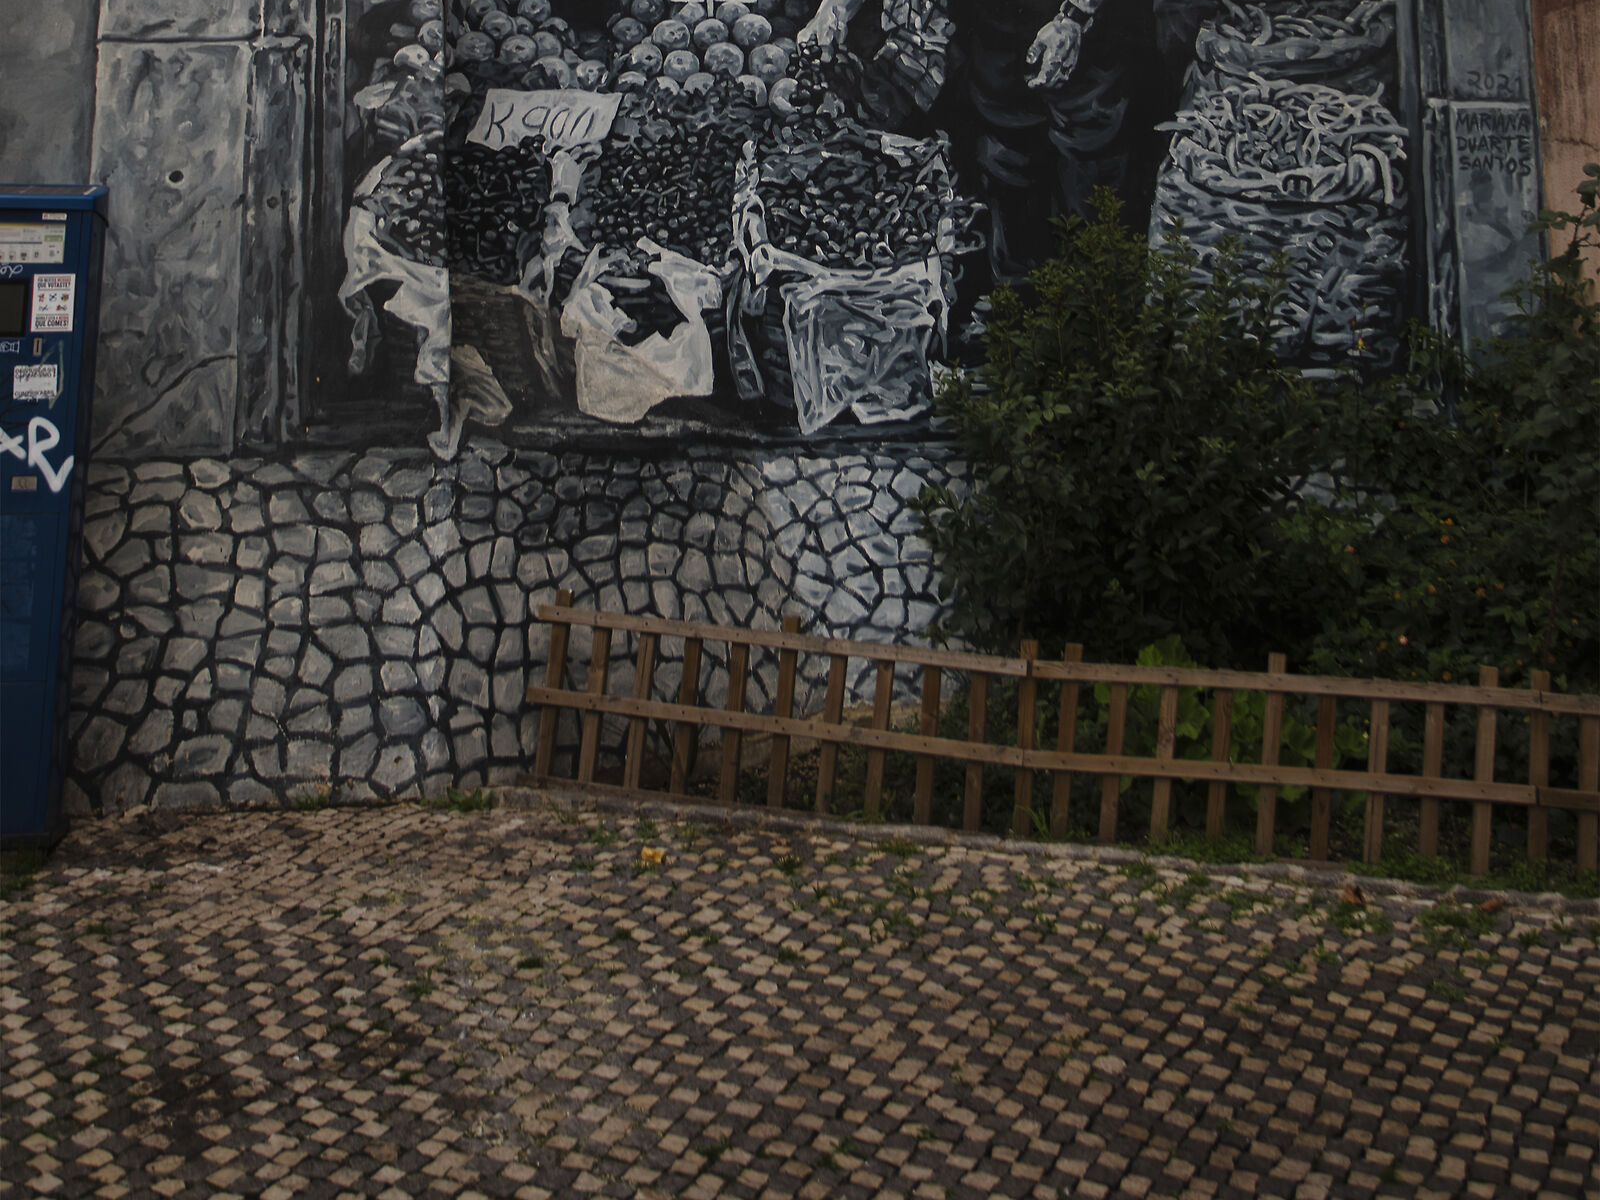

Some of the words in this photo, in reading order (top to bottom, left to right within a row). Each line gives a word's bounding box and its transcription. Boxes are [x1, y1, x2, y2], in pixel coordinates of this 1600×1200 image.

[1467, 70, 1522, 97] 2021
[484, 102, 514, 142] K
[1456, 110, 1530, 132] MARIANA
[1456, 135, 1530, 153] DUARTE
[1459, 154, 1530, 176] SANTOS
